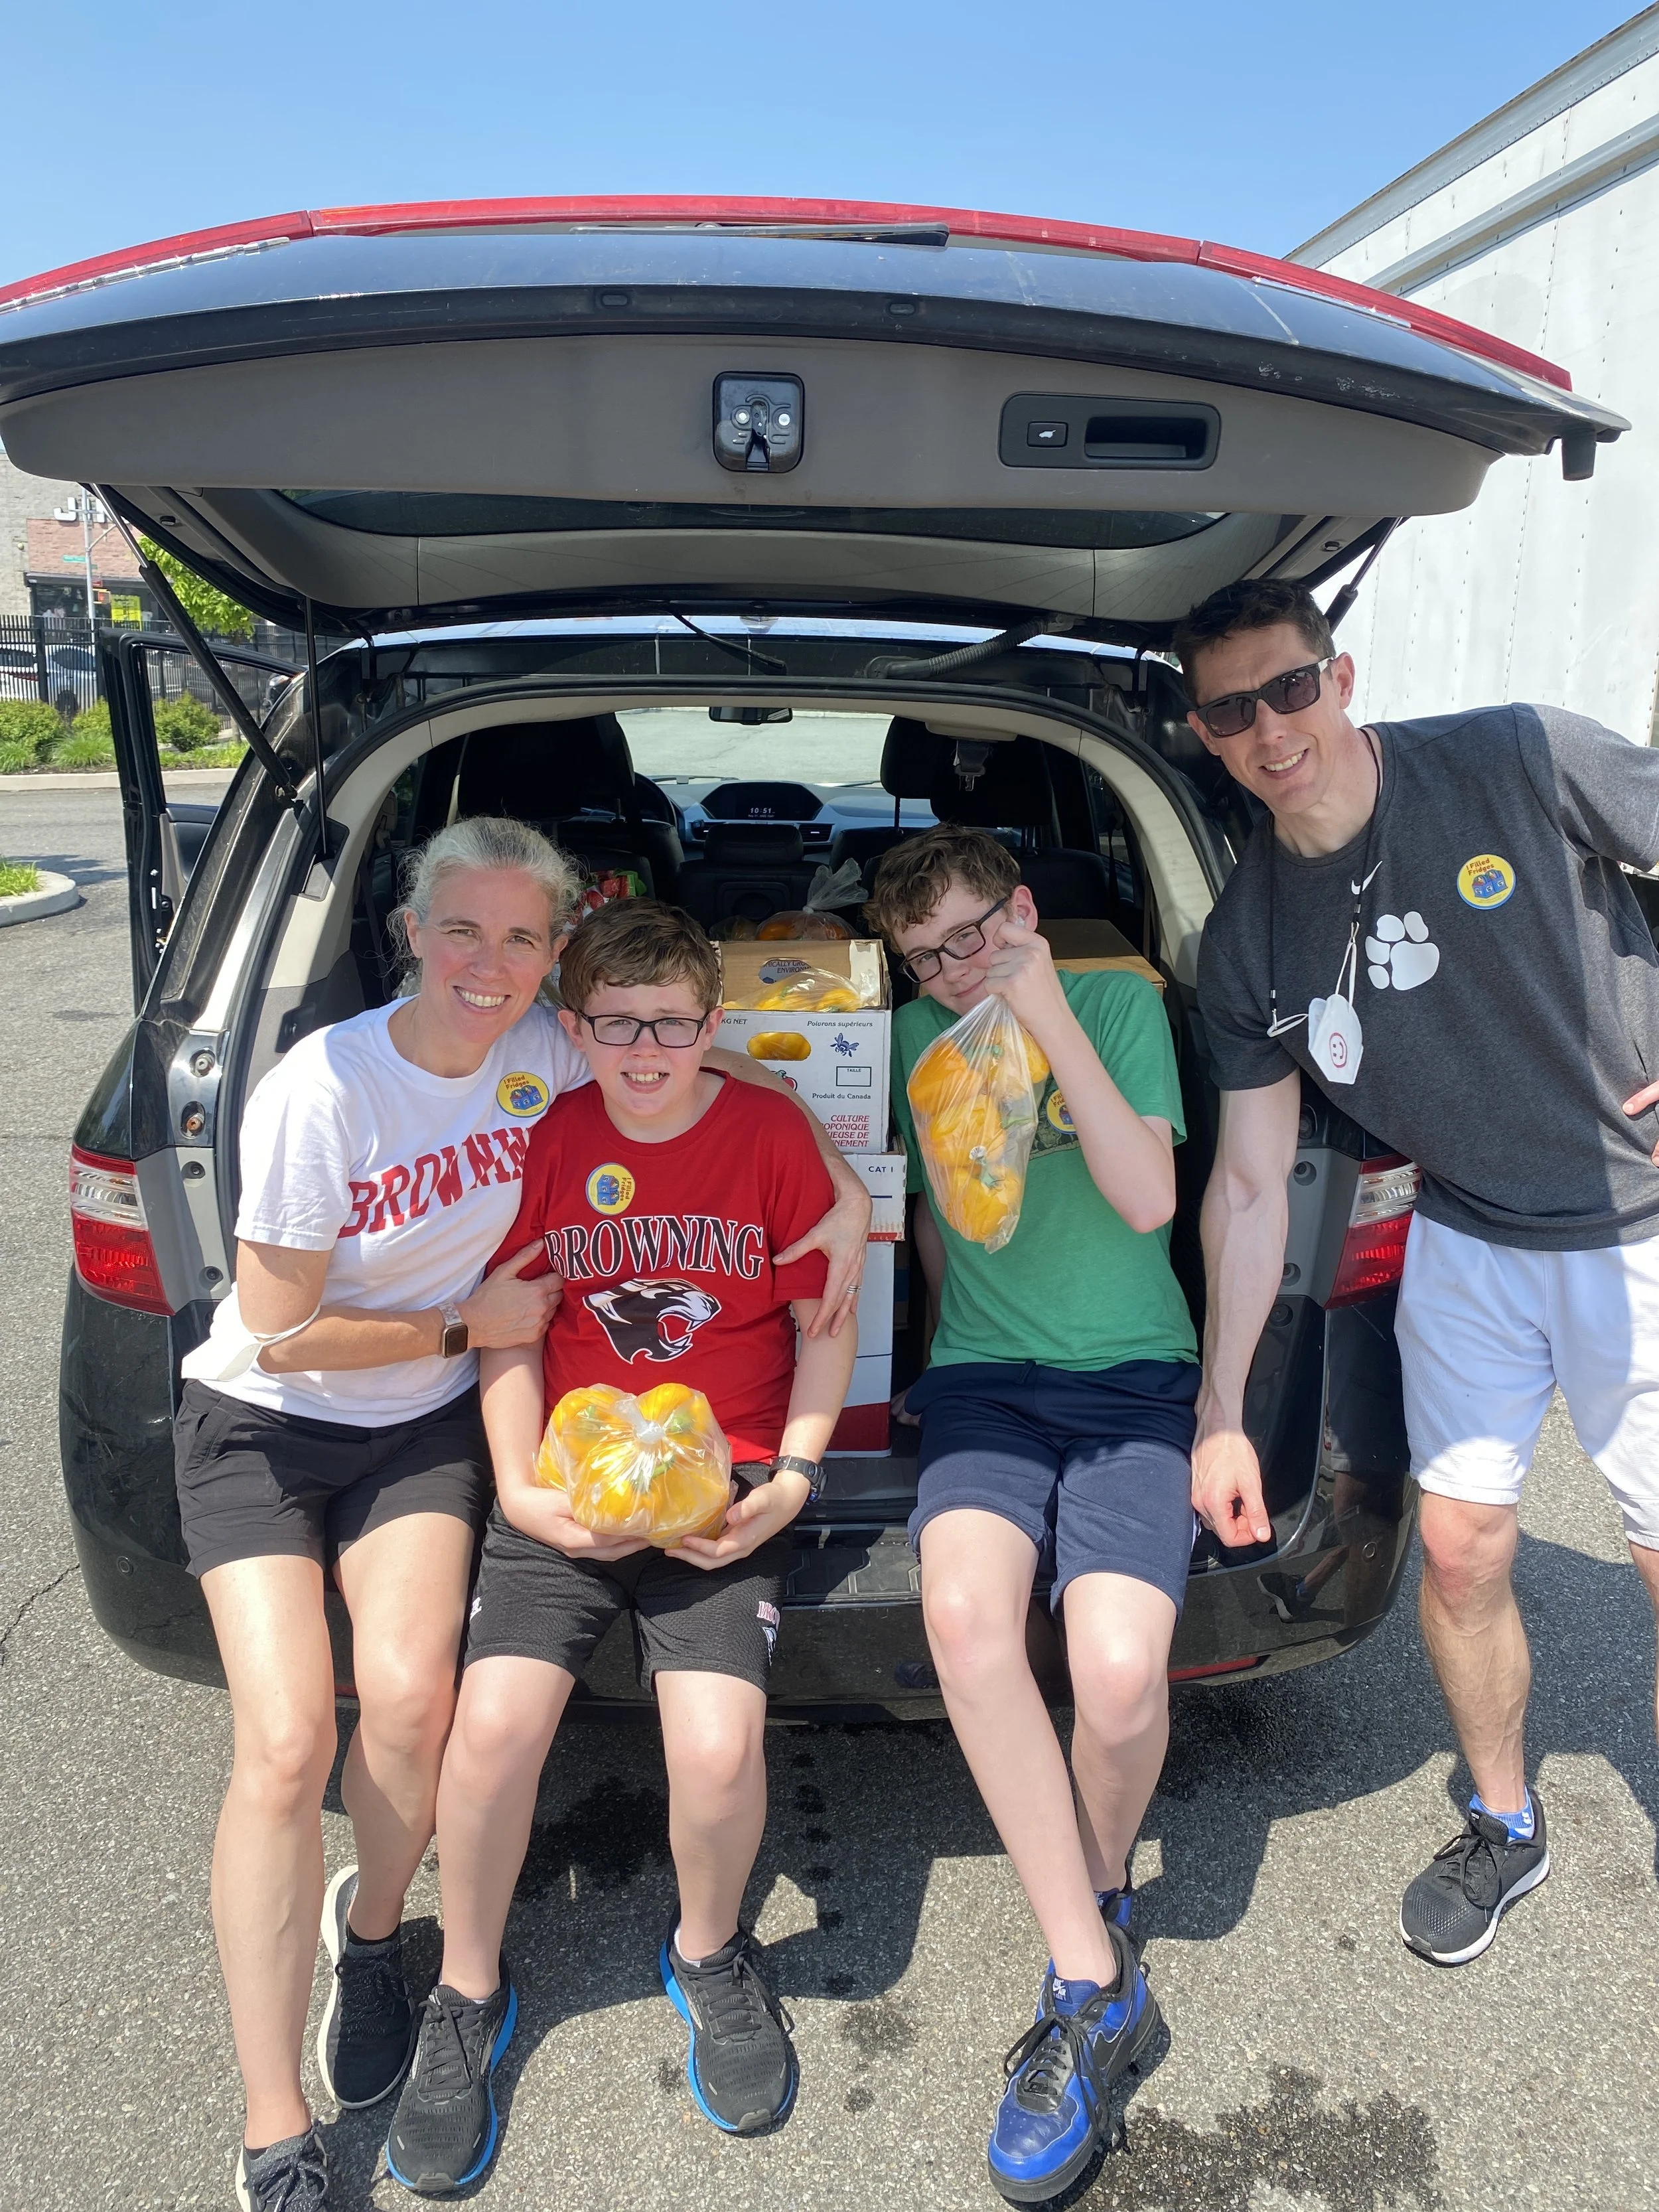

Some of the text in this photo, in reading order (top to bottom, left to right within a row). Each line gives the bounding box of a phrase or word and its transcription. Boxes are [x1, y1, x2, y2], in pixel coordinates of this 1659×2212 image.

[1468, 863, 1494, 876] Fridges
[1470, 858, 1490, 869] Filled
[506, 1080, 530, 1090] Fridges
[544, 1215, 764, 1280] BROWNING
